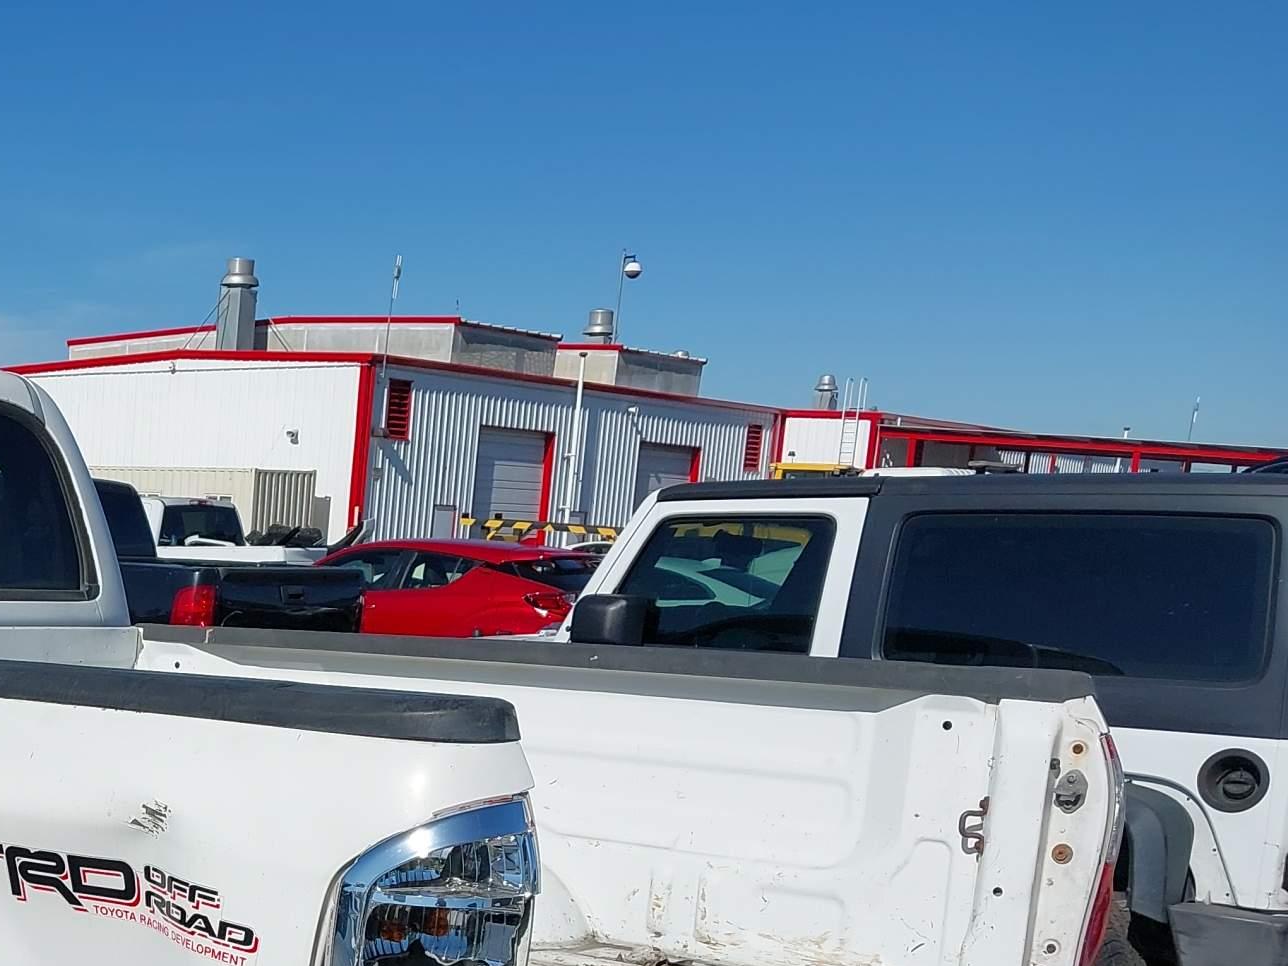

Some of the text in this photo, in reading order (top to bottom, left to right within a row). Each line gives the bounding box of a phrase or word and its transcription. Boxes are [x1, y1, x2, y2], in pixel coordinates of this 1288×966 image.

[144, 865, 220, 910] OFF
[93, 904, 137, 922] TOYOTA
[139, 914, 170, 938] RACING
[144, 890, 259, 953] ROAD
